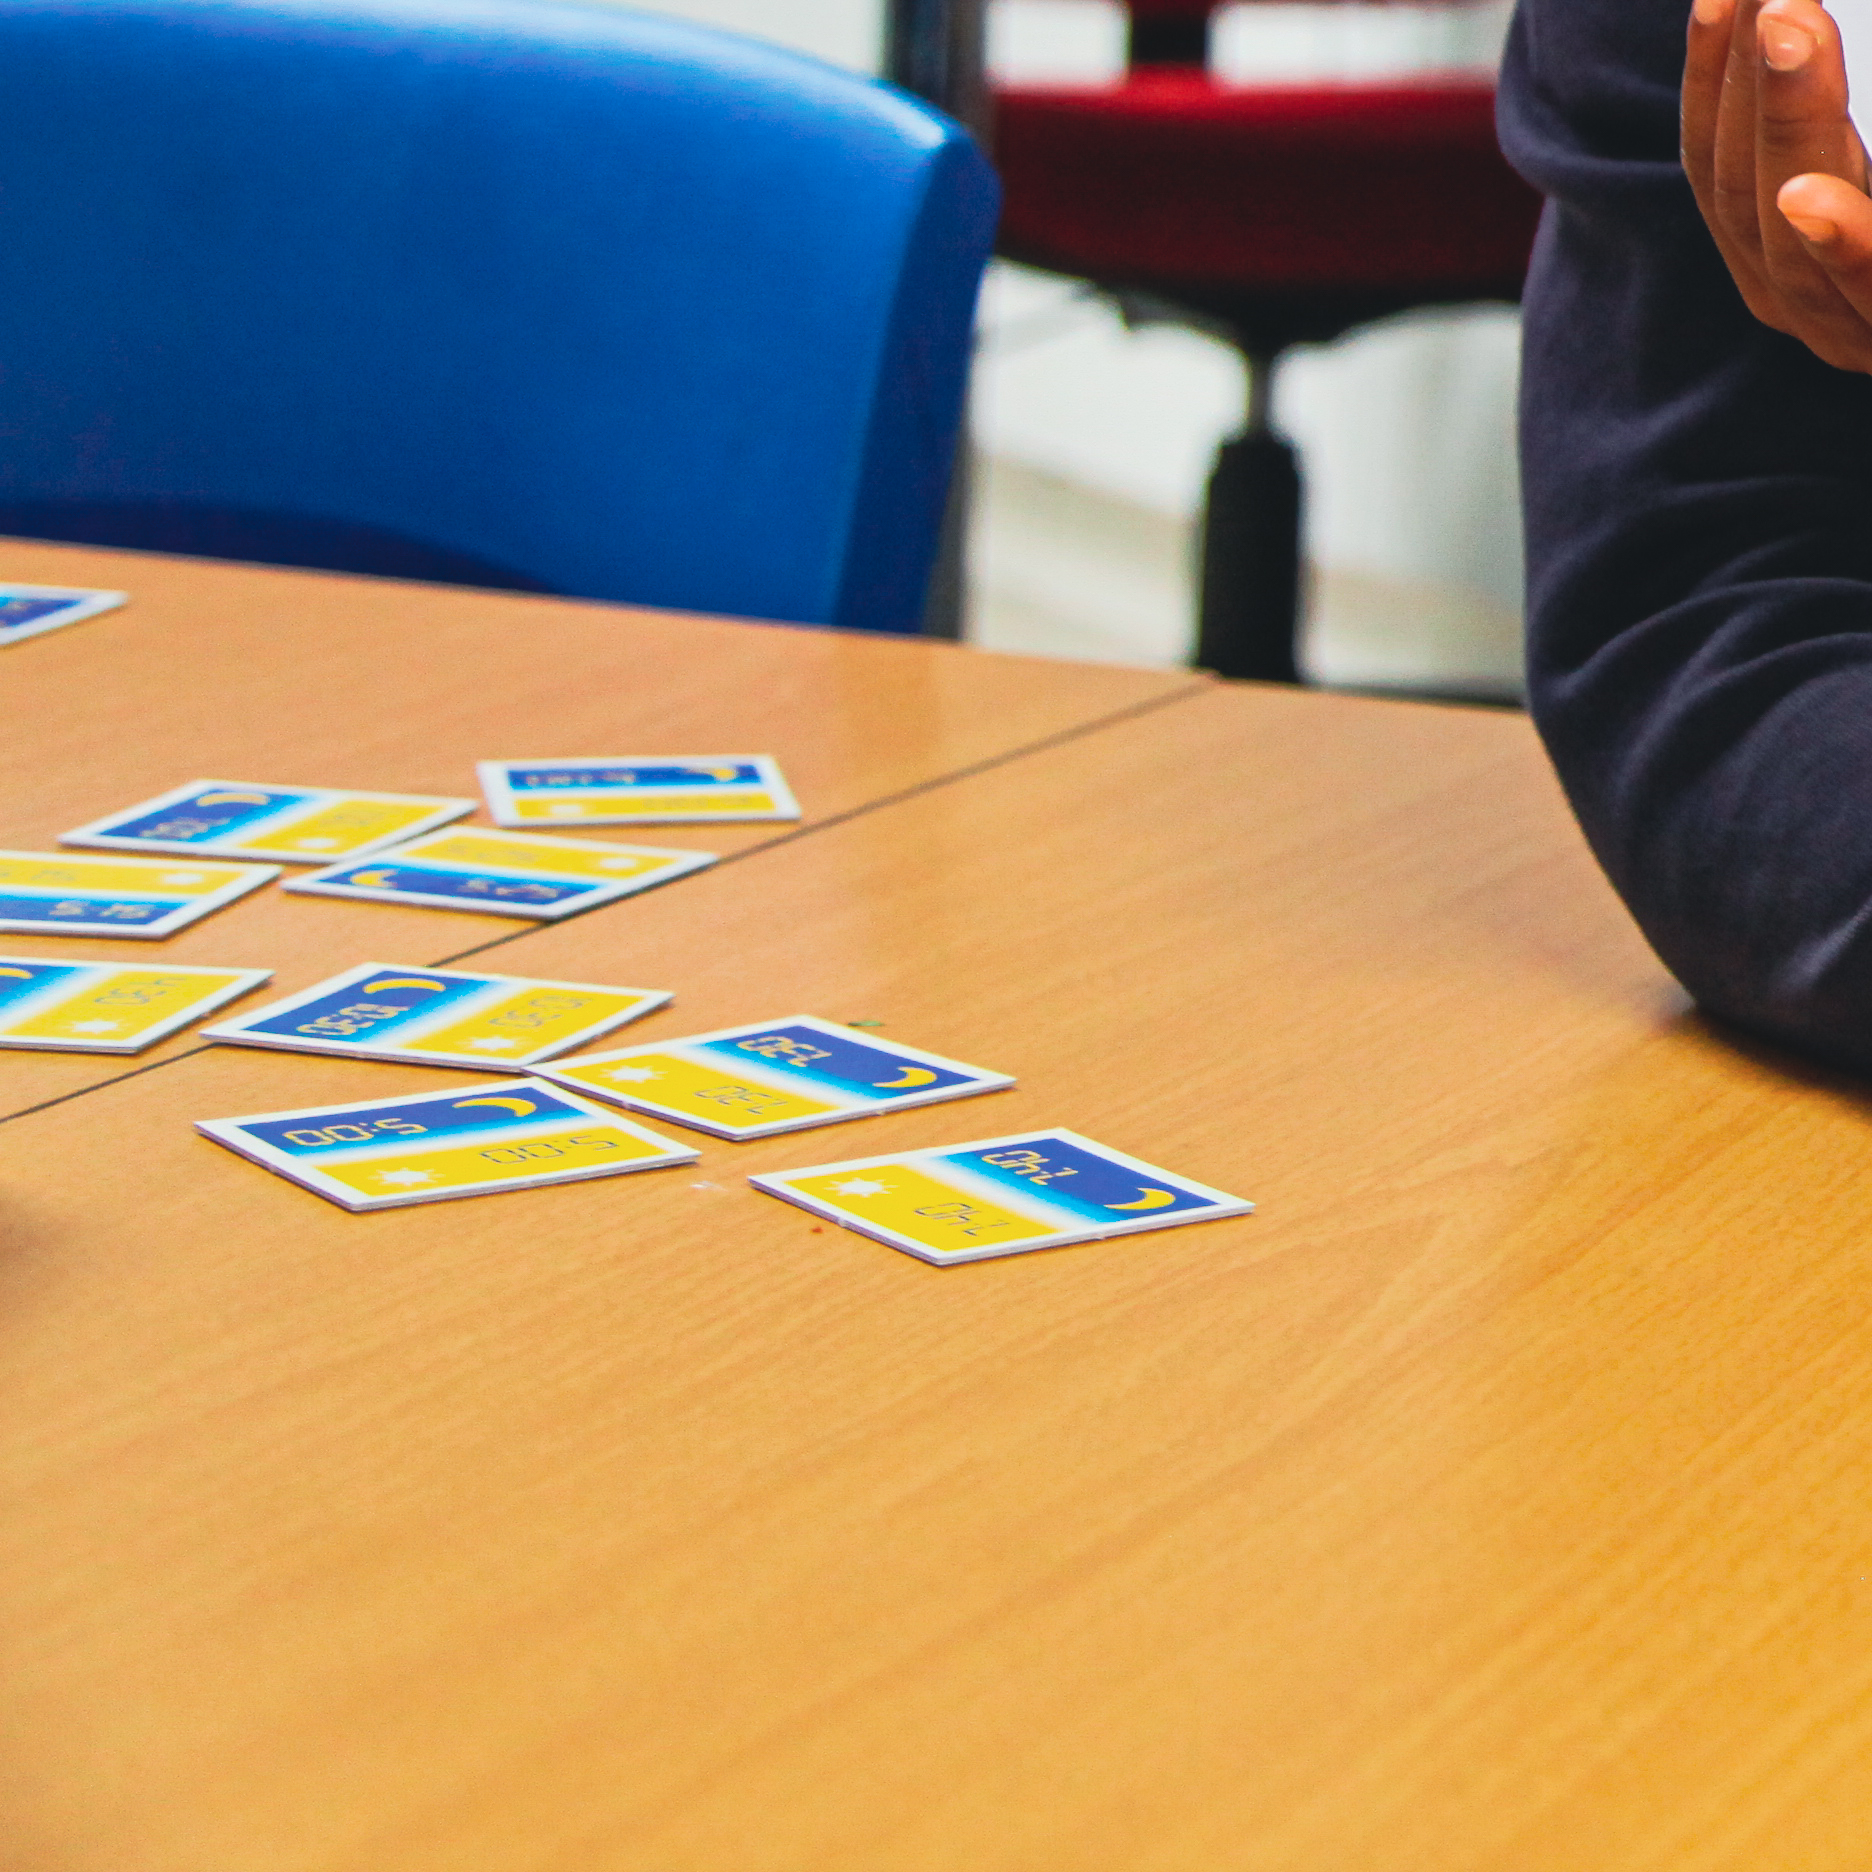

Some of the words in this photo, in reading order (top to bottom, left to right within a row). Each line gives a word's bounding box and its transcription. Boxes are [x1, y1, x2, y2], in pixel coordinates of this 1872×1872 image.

[281, 1117, 427, 1147] 5:00
[478, 1134, 617, 1165] 5:00
[980, 1149, 1078, 1187] 7:40
[912, 1201, 1011, 1238] 7:40
